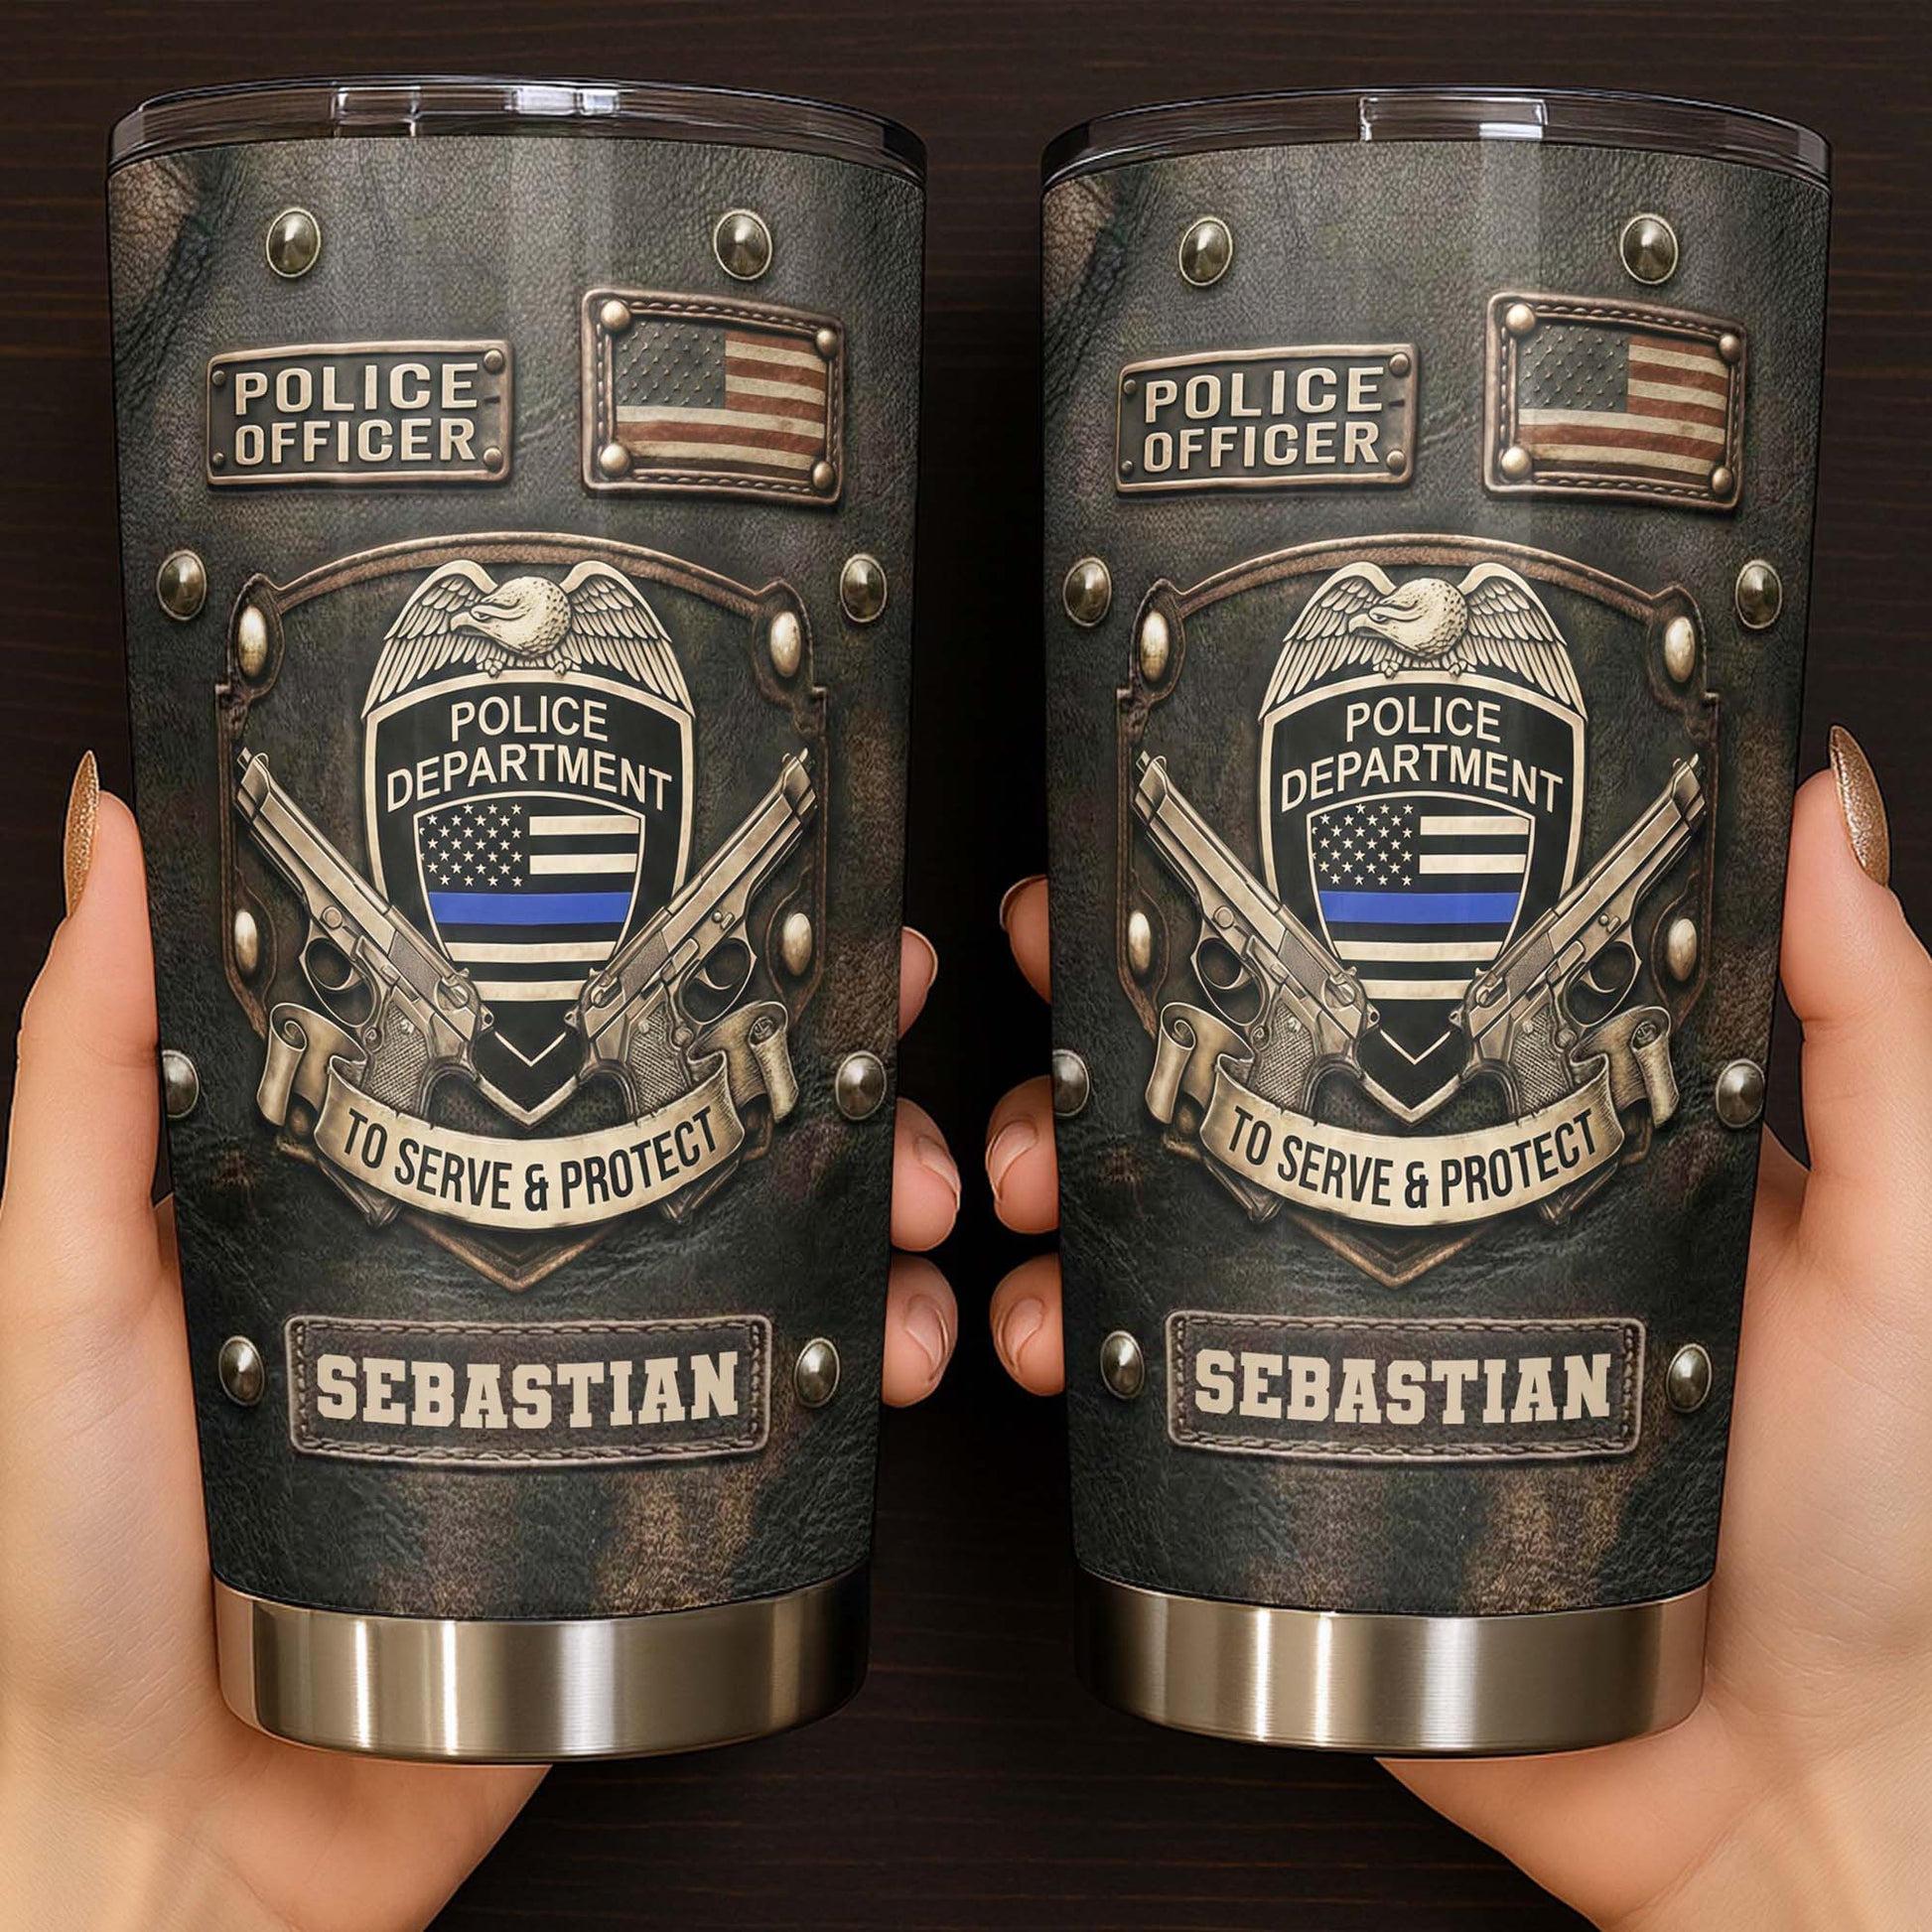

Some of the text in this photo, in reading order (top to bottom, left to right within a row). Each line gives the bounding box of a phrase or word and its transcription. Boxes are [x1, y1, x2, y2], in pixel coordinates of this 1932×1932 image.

[235, 363, 479, 416] POLICE
[1145, 366, 1384, 424] POLICE
[234, 418, 476, 466] OFFICER
[1144, 421, 1380, 474] OFFICER
[451, 695, 609, 742] POLICE
[1346, 696, 1501, 743] POLICE
[387, 744, 672, 812] DEPARTMENT
[1281, 744, 1564, 813] DEPARTMENT
[344, 1105, 717, 1211] TO SERVE & PROTECT
[1228, 1105, 1596, 1208] TO SERVE & PROTECT
[316, 1350, 739, 1430] SEBASTIAN
[1194, 1348, 1611, 1425] SEBASTIAN
